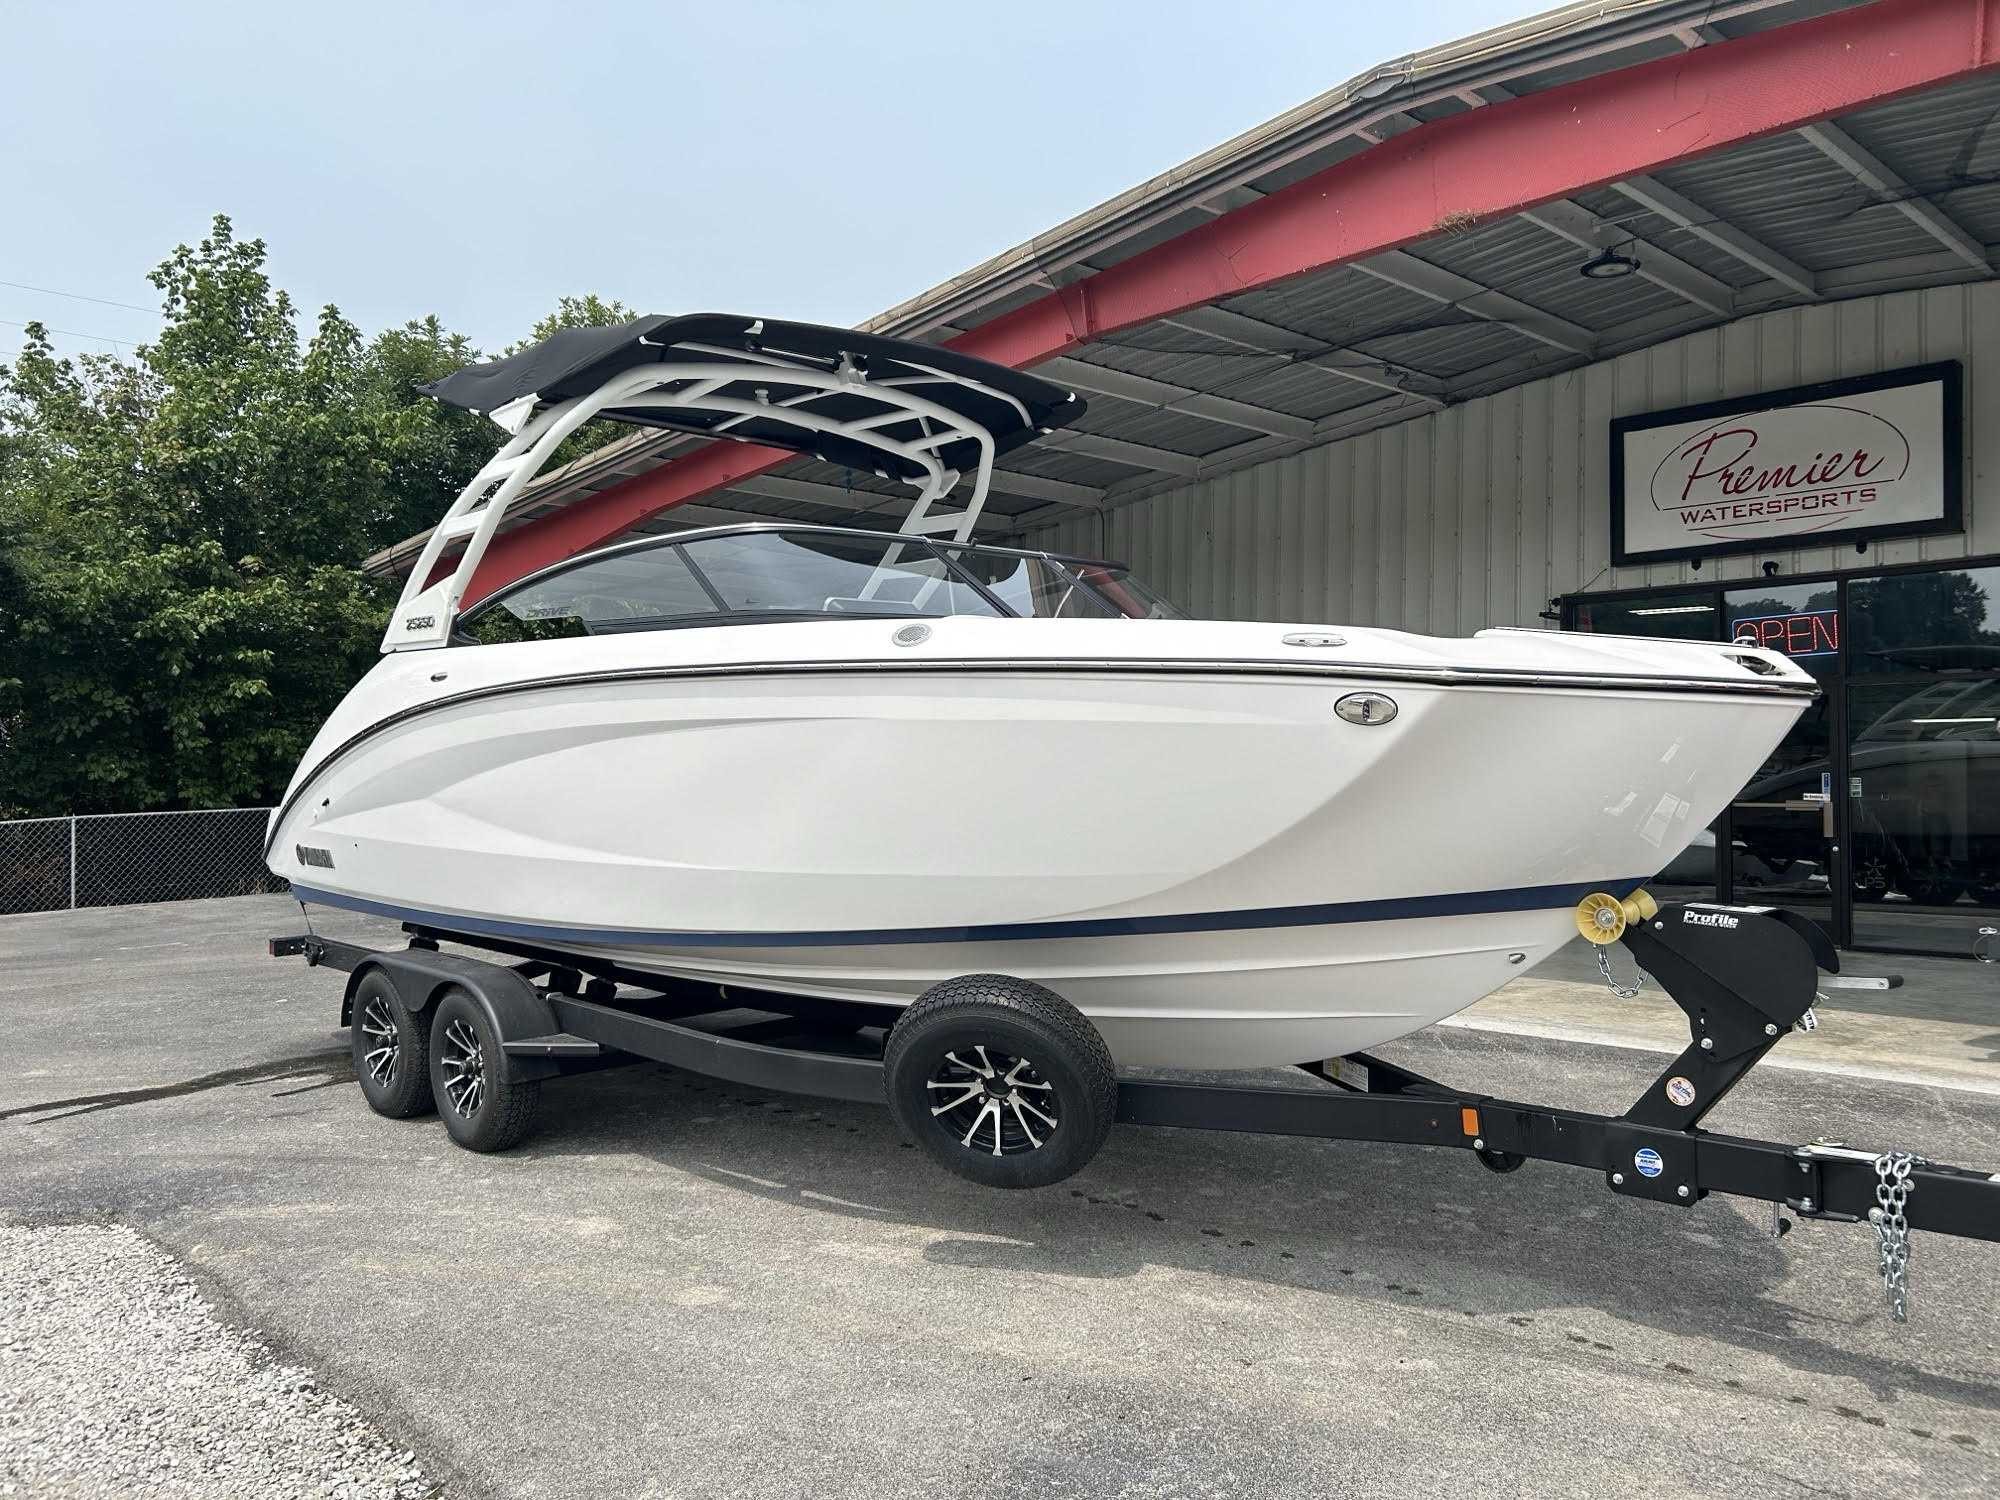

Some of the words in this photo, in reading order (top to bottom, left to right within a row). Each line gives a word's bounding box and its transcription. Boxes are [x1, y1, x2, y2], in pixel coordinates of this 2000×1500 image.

[1680, 428, 1885, 501] Premier
[1680, 488, 1877, 525] WATERSPORTS
[1736, 613, 1839, 653] OPEN
[1683, 910, 1739, 926] Profile
